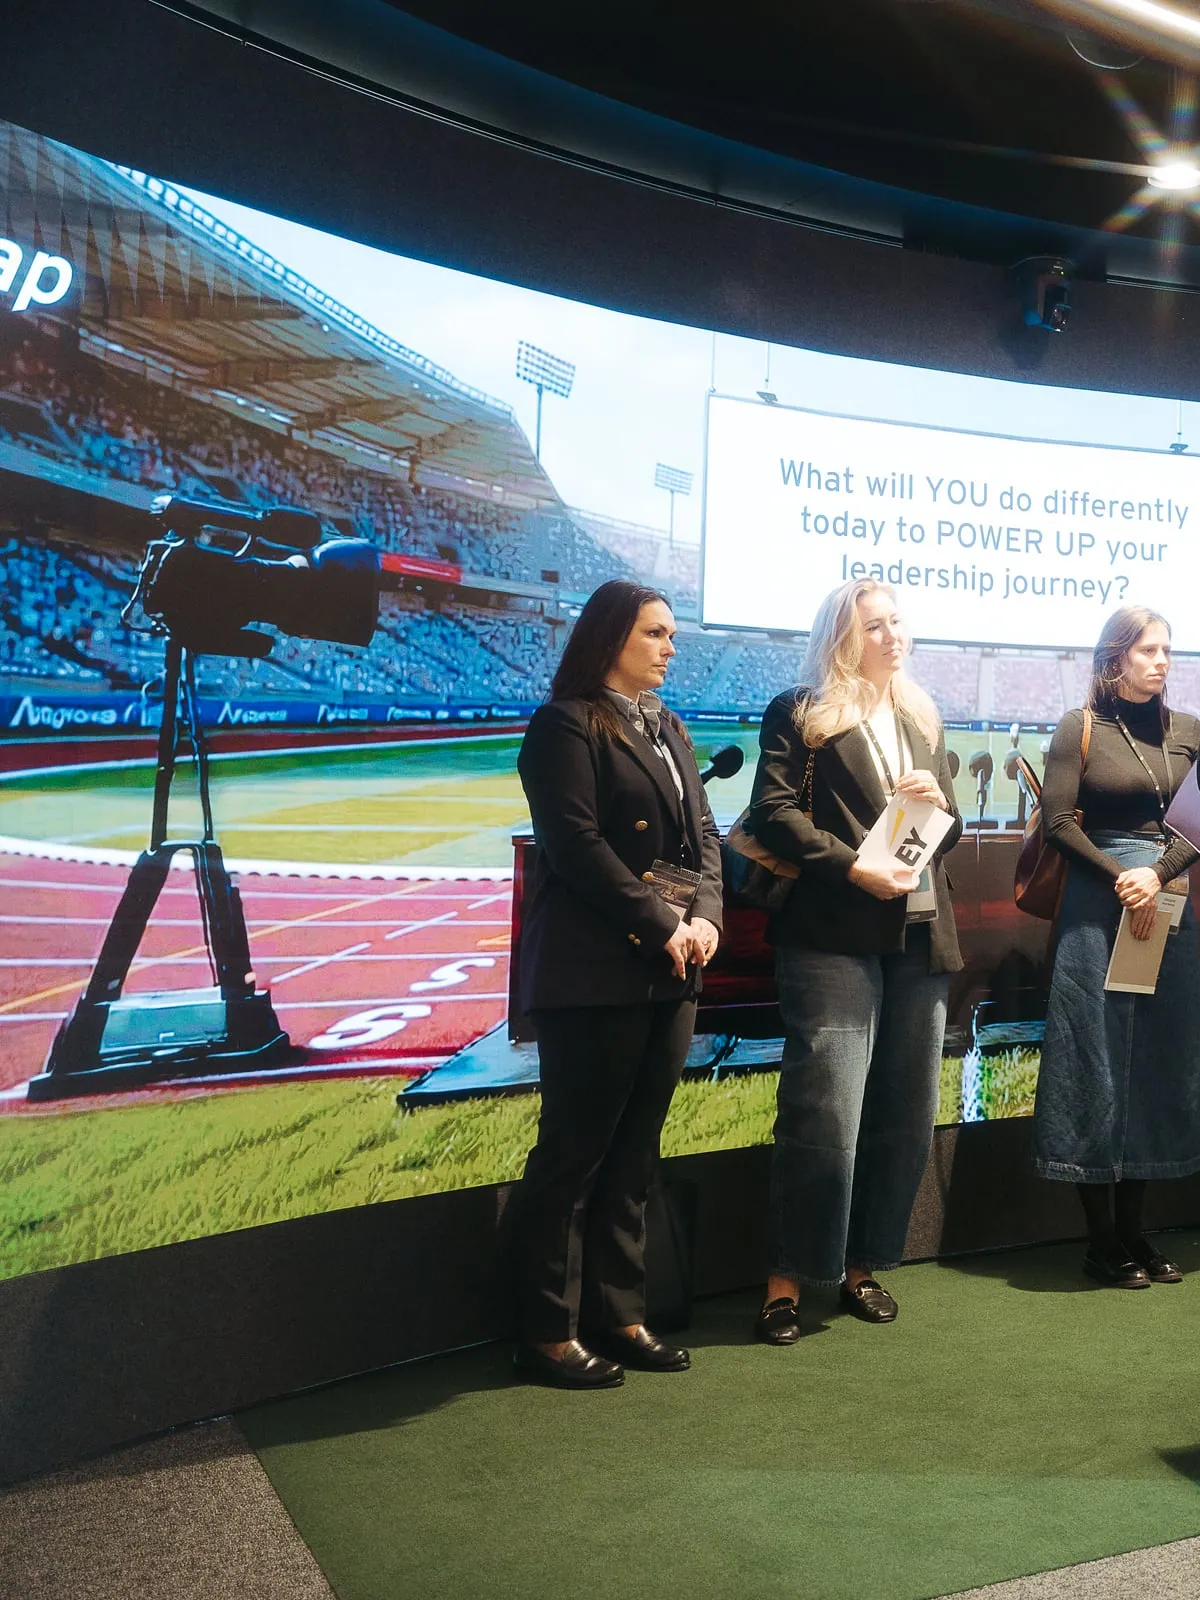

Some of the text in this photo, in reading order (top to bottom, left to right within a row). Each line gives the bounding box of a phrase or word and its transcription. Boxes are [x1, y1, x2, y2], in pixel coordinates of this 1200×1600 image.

[780, 457, 1189, 530] What will YOU do differently
[801, 505, 1168, 565] today to POWER UP your
[842, 553, 1129, 605] leadership journey?
[894, 827, 927, 867] EY
